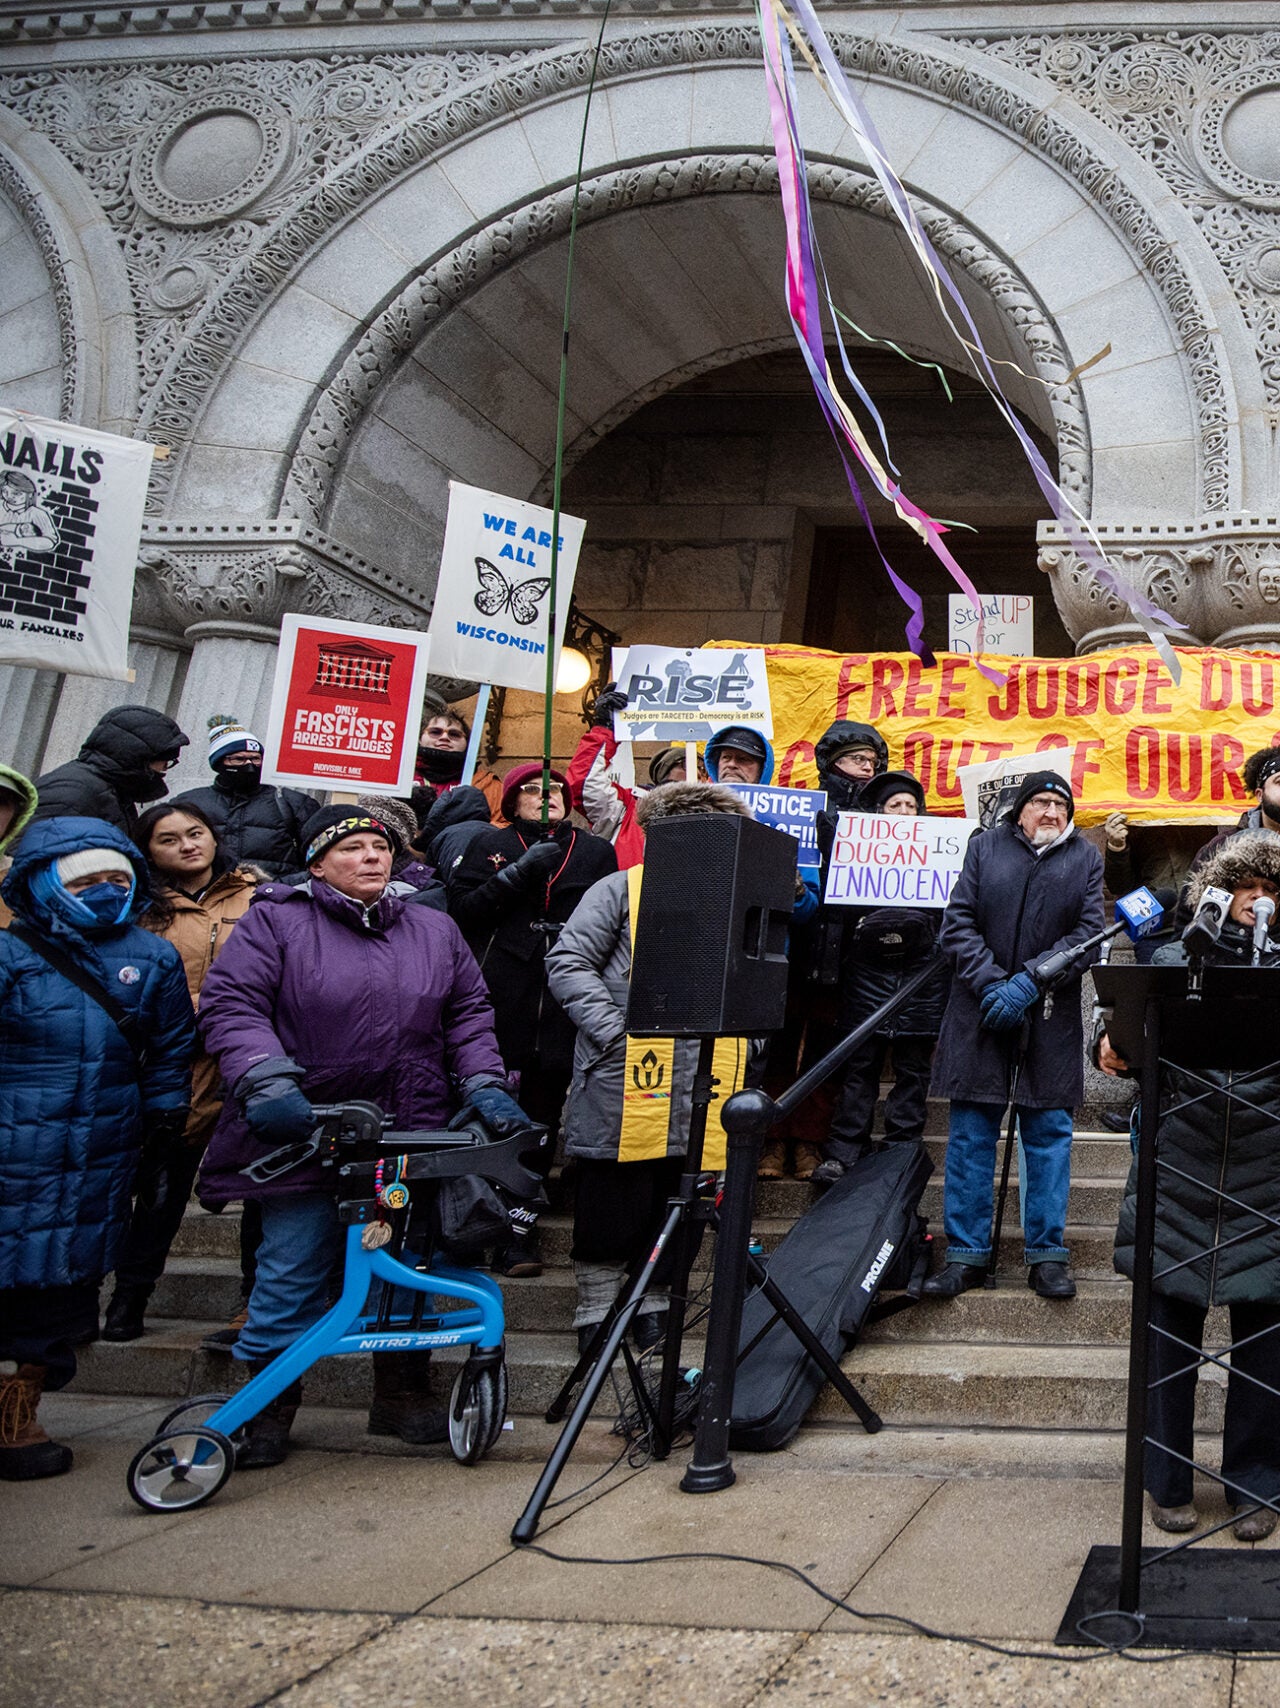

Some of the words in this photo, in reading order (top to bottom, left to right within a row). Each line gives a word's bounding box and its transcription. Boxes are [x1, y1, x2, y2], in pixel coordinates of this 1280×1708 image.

[483, 512, 517, 536] WE
[498, 543, 536, 568] ALL
[1001, 596, 1031, 624] UP
[0, 618, 14, 630] UR
[20, 621, 85, 642] FAMILIES
[456, 621, 546, 655] WISCONSIN
[626, 674, 749, 704] RISE
[835, 656, 970, 721] FREE
[988, 656, 1174, 721] JUDGE
[335, 704, 359, 716] ONLY
[623, 712, 647, 720] Judges
[699, 712, 734, 720] Democracy
[294, 709, 396, 741] FASCISTS
[293, 731, 343, 748] ARREST
[346, 737, 393, 754] JUDGES
[1126, 726, 1247, 801] OUR
[837, 815, 928, 843] JUDGE
[835, 840, 929, 866] DUGAN
[931, 835, 960, 856] IS
[508, 1206, 538, 1223] drive
[860, 1239, 895, 1293] PROLINE
[359, 1338, 411, 1349] NITRO
[415, 1335, 461, 1346] SPRINT
